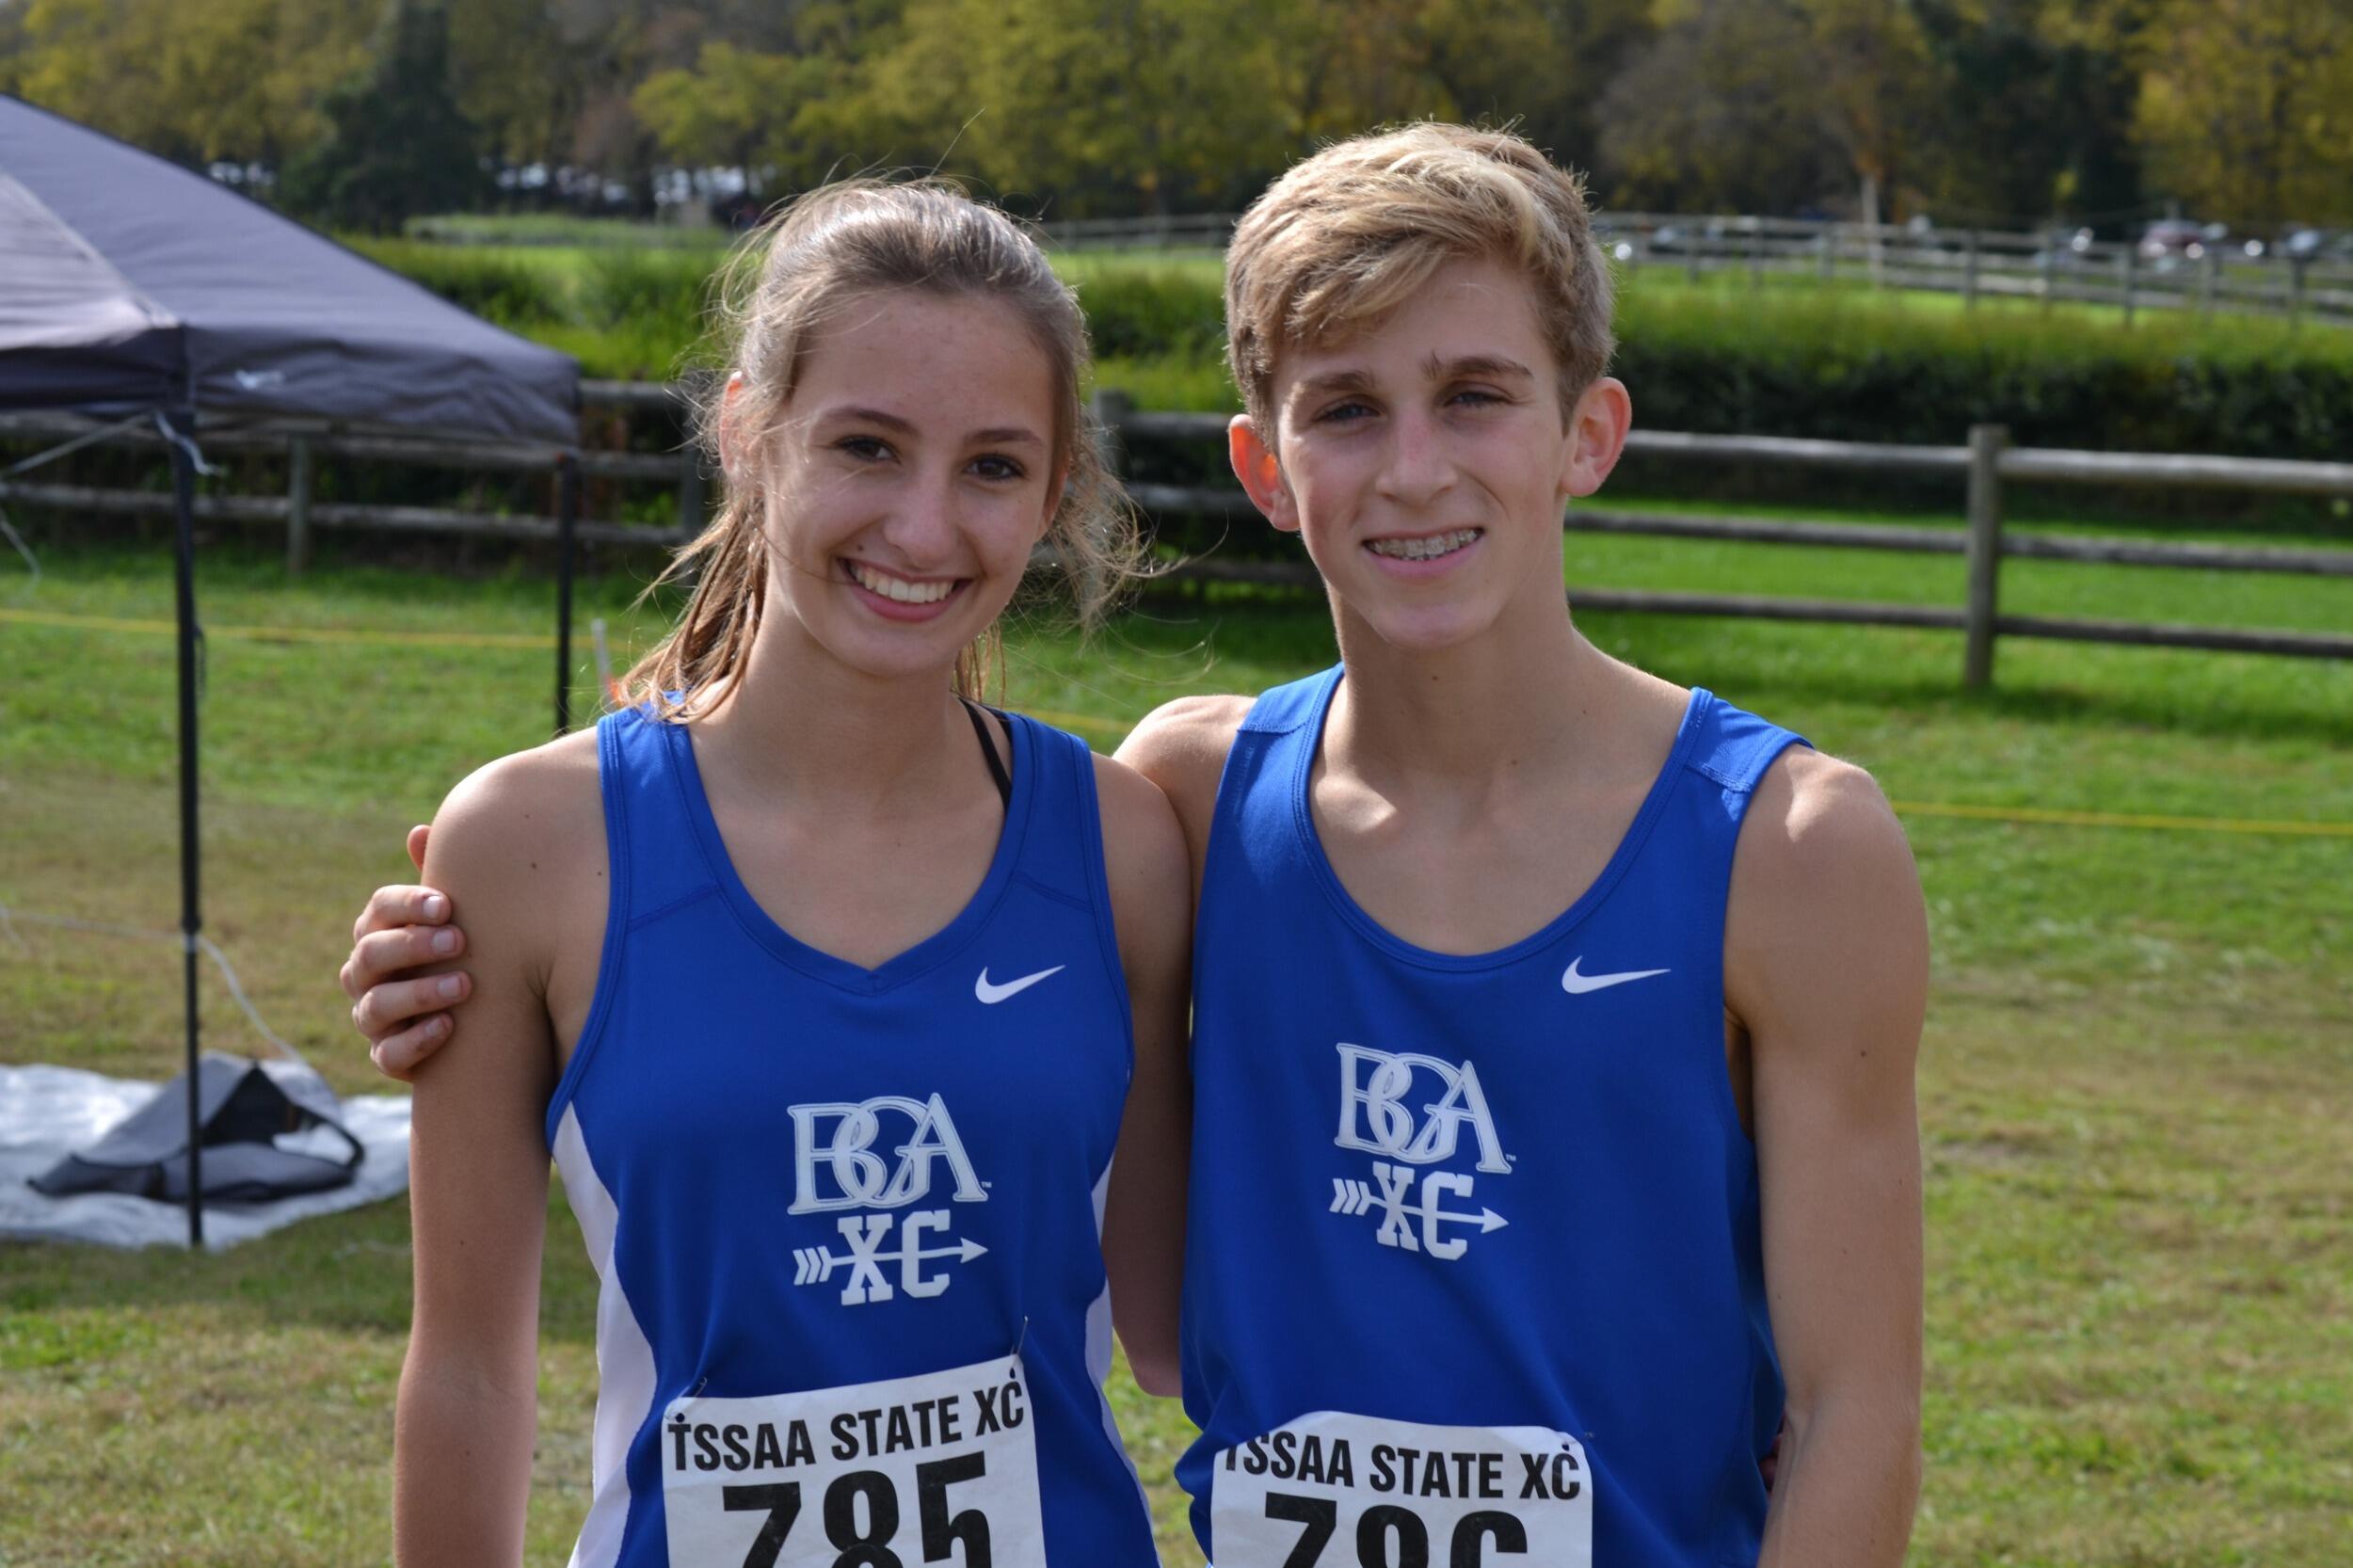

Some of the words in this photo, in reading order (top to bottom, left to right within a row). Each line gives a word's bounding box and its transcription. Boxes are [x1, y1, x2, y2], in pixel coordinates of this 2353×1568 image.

[1372, 1160, 1474, 1260] XC
[838, 1209, 951, 1305] XC
[667, 1420, 816, 1471] TSSAA
[830, 1396, 962, 1461] STATE
[973, 1381, 1024, 1436] XC
[1369, 1444, 1503, 1493] STATE
[1519, 1452, 1581, 1500] XC
